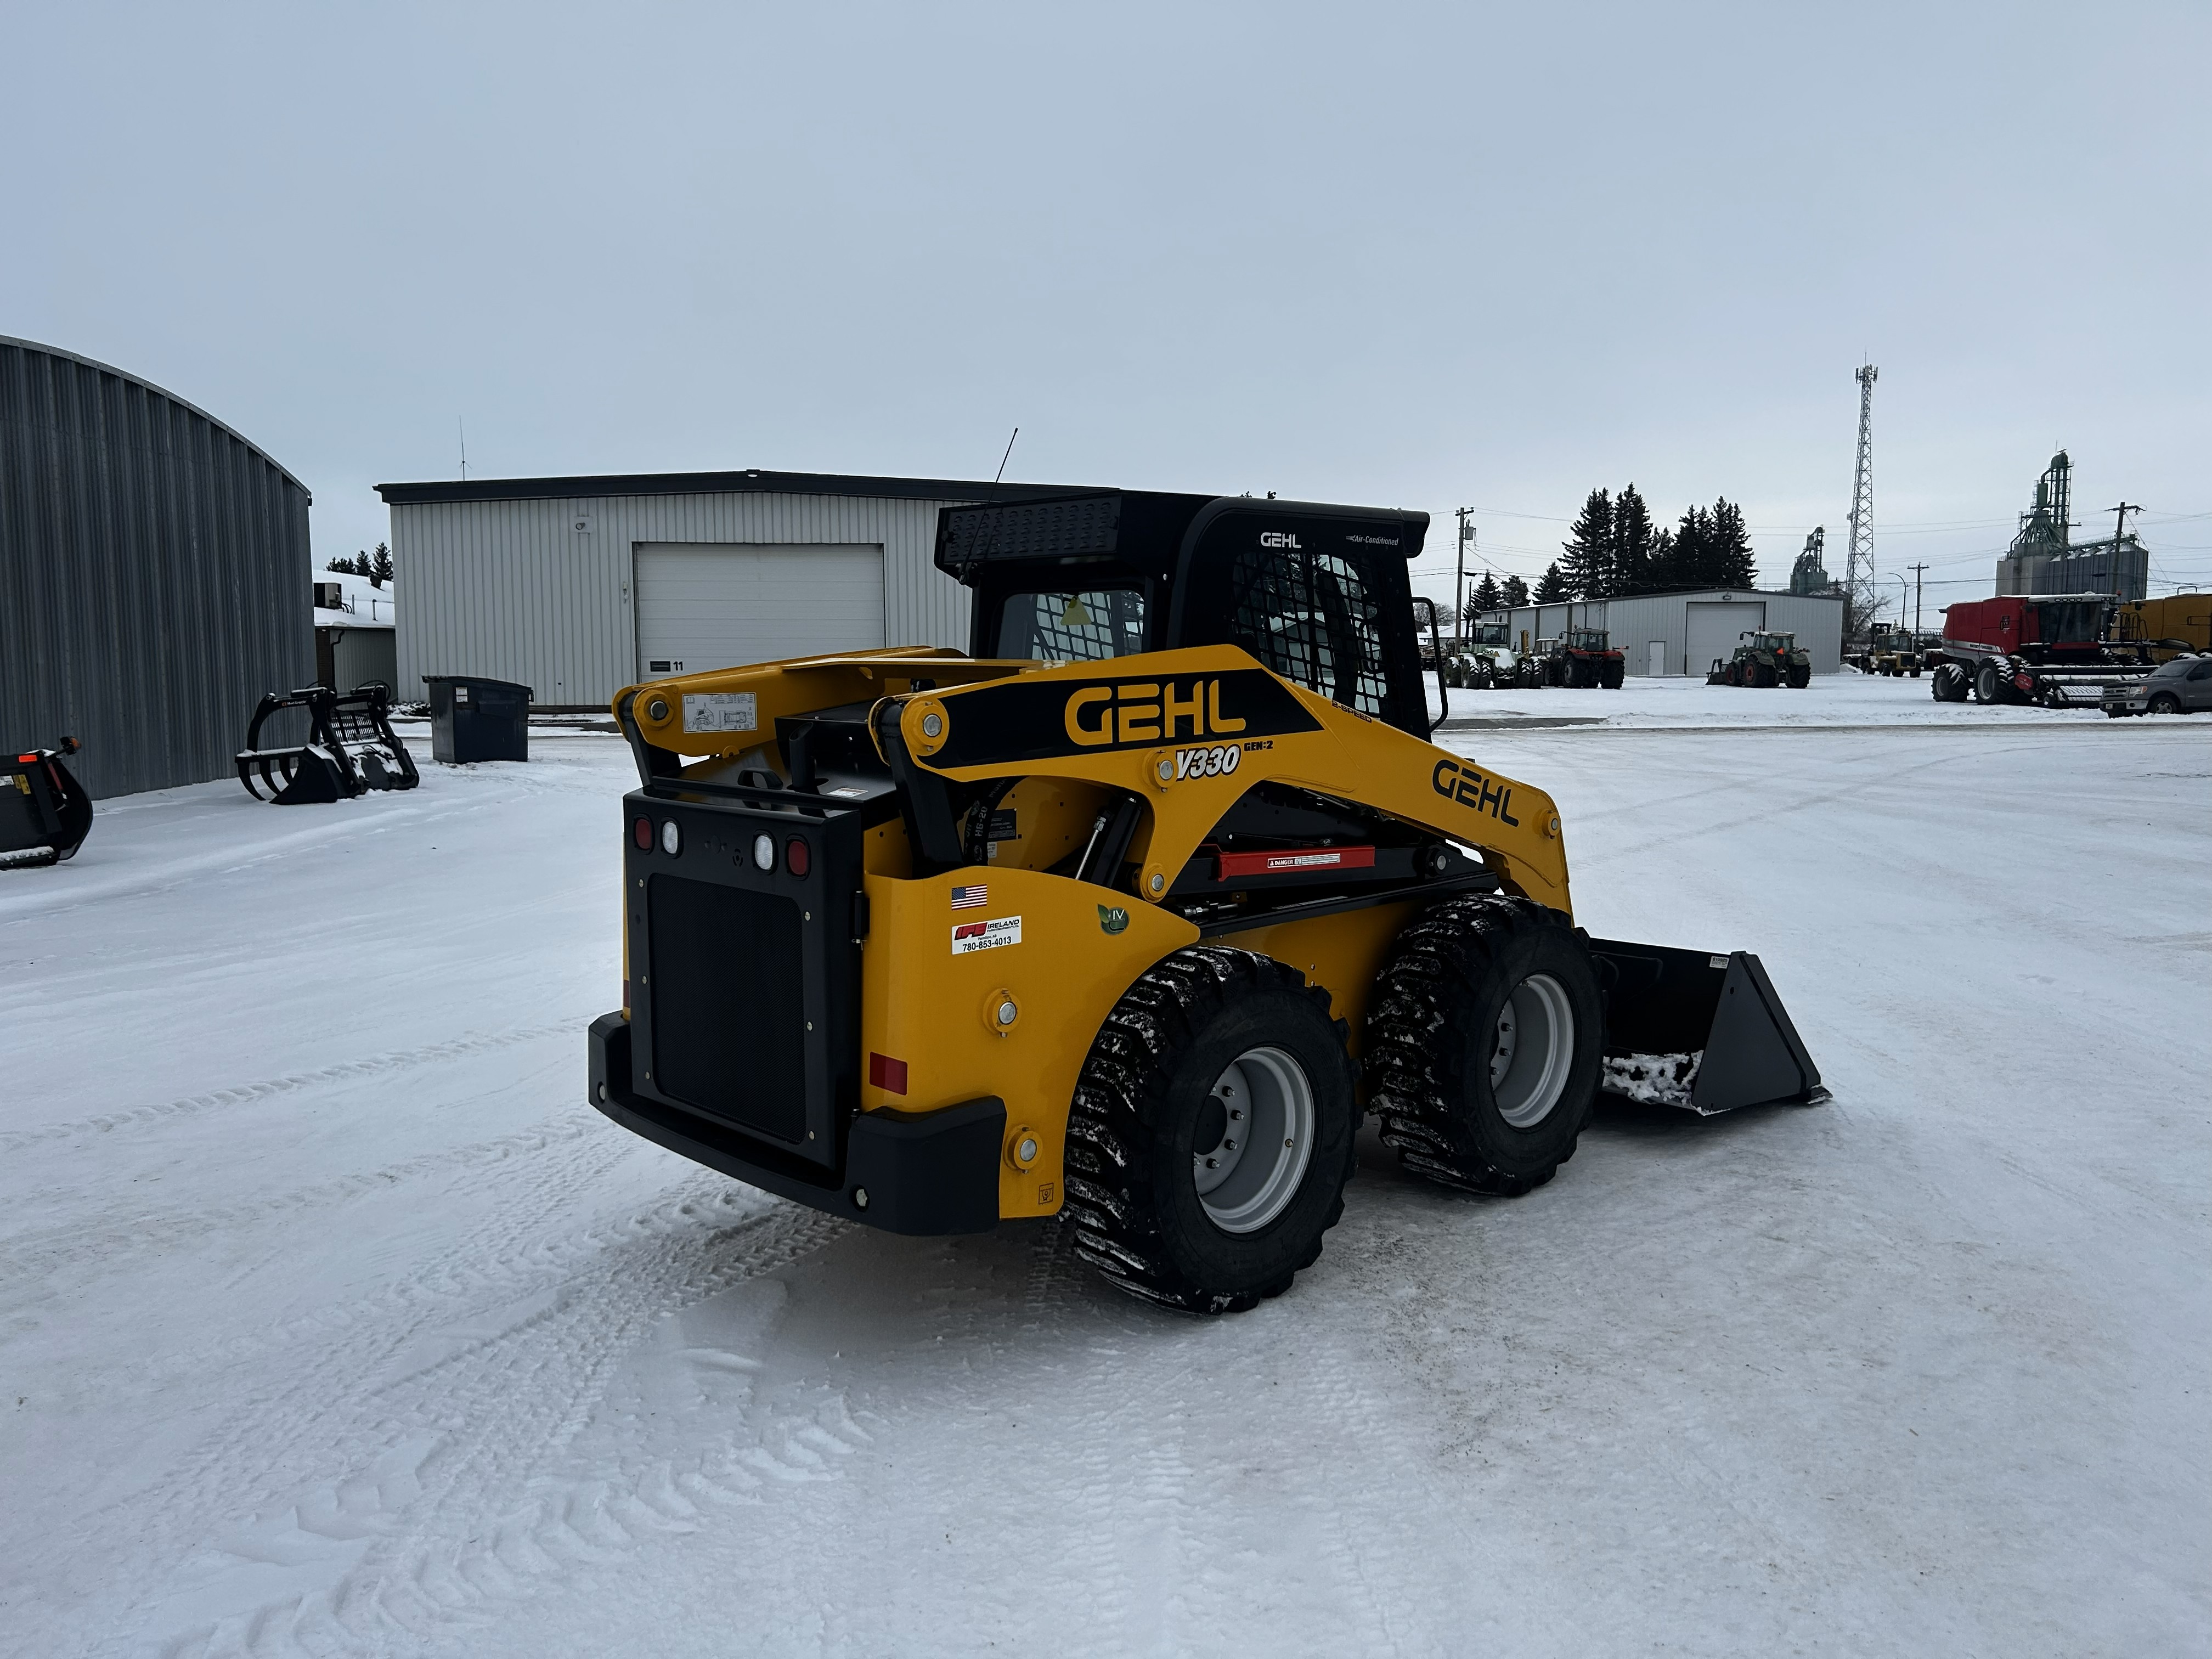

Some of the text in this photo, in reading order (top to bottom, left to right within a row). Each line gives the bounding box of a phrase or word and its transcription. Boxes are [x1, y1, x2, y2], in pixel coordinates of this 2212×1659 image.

[1261, 532, 1302, 549] GEHL
[1354, 535, 1399, 546] Air-Conditioned
[673, 661, 684, 671] 11
[1065, 679, 1246, 746] GEHL
[1331, 700, 1373, 724] 2-SPEED
[1175, 740, 1273, 782] V330 GEN:2
[1432, 759, 1519, 827] GEHL
[1113, 909, 1126, 921] IV
[987, 919, 1019, 930] IRELAND
[963, 936, 1011, 951] 780-853-4013
